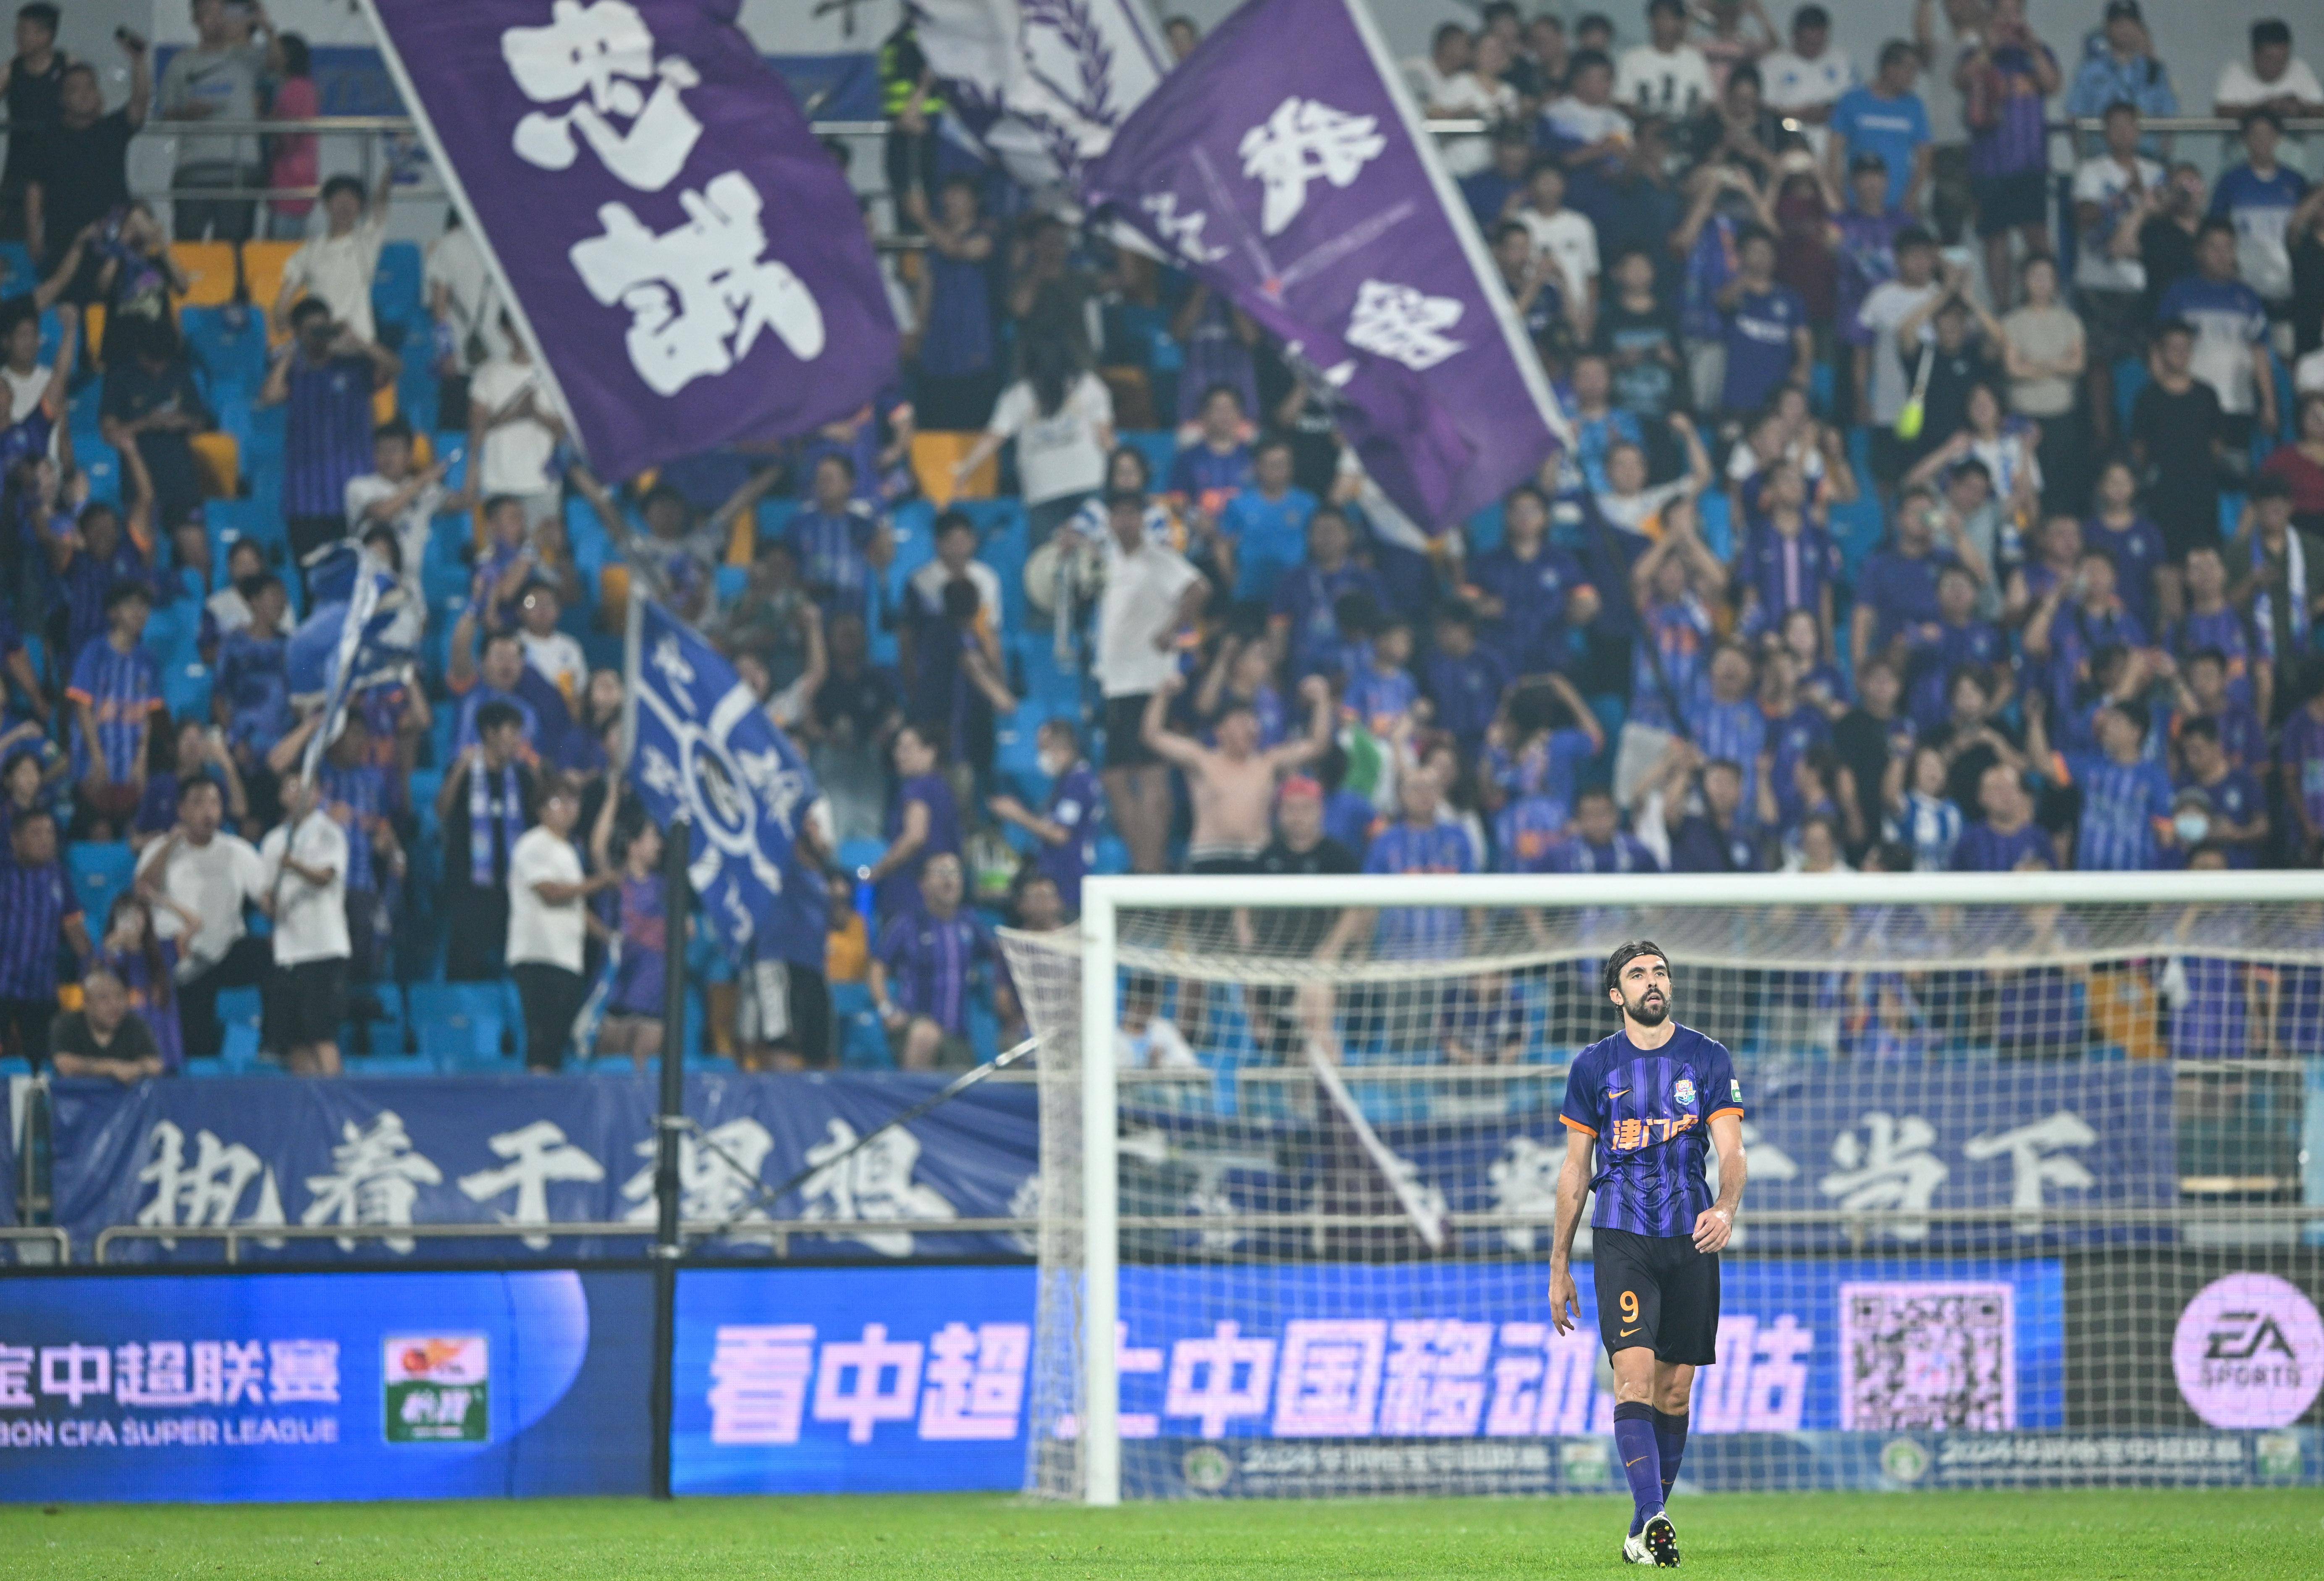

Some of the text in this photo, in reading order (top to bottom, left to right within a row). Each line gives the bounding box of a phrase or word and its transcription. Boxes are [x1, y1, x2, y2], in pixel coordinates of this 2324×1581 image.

[1619, 1290, 1639, 1324] 9
[2204, 1311, 2295, 1359] EA
[707, 1315, 1814, 1445] 看中超 上中国移动咕
[2201, 1363, 2301, 1387] SPORTS
[58, 1418, 117, 1446] CFA
[122, 1417, 219, 1446] SUPER
[223, 1416, 339, 1445] LEAGUE
